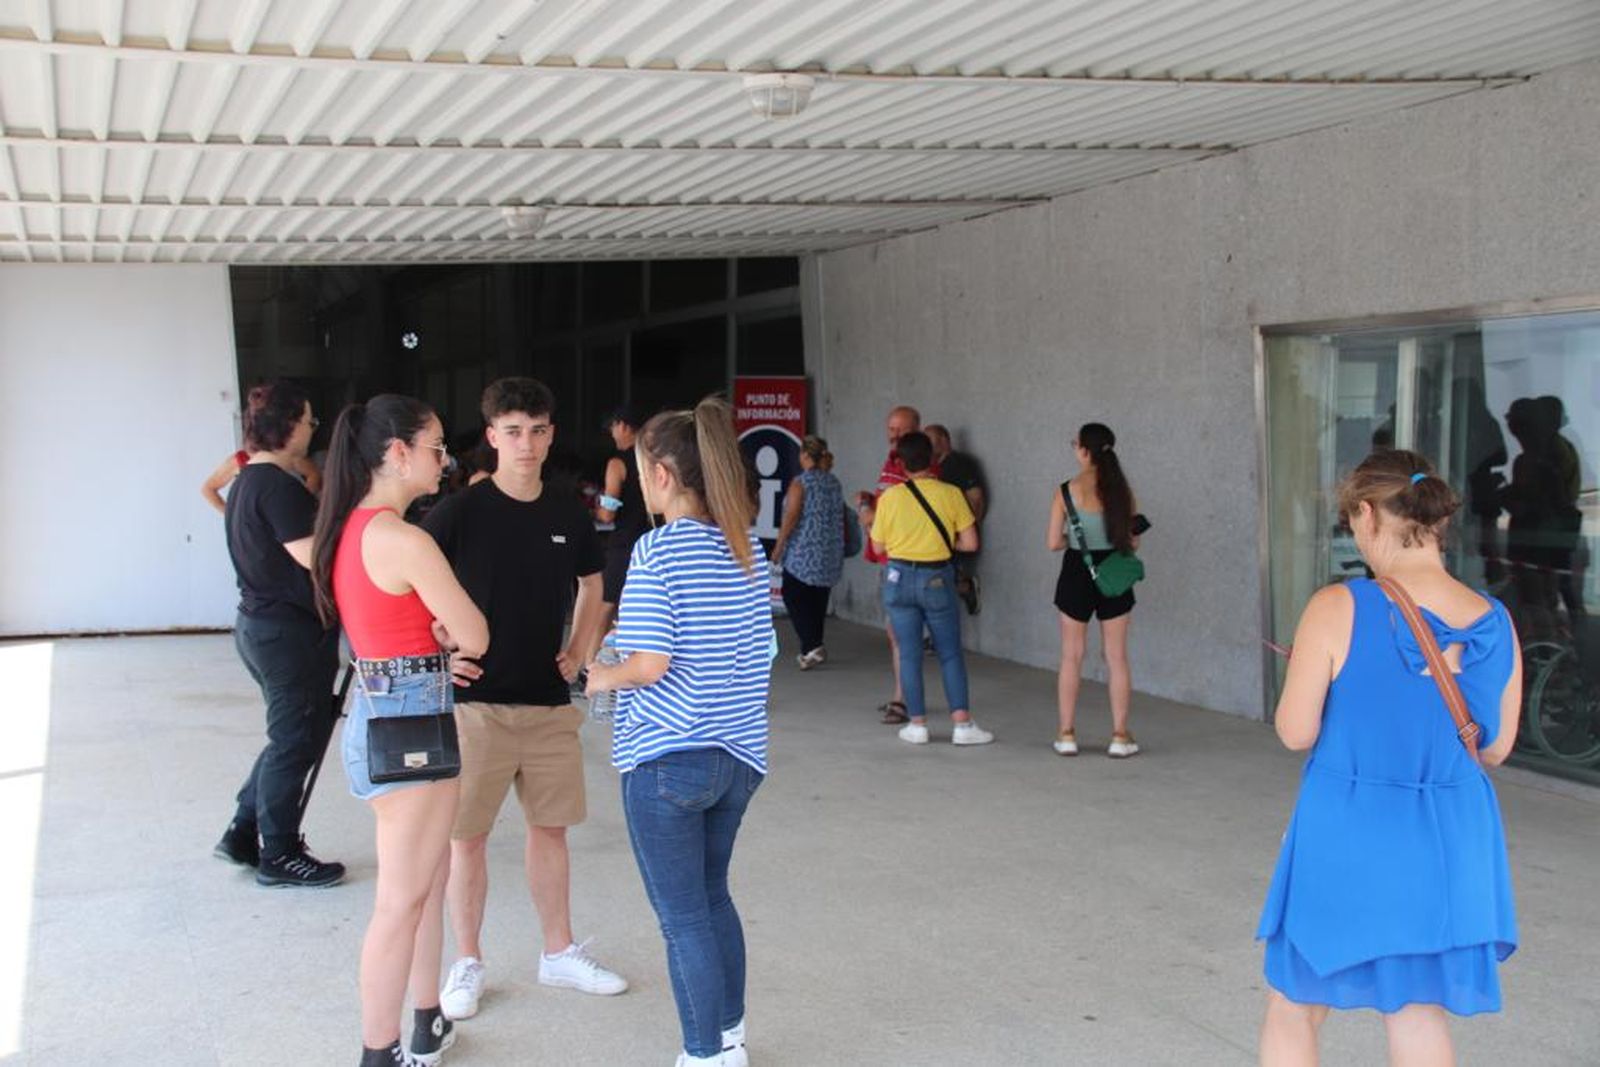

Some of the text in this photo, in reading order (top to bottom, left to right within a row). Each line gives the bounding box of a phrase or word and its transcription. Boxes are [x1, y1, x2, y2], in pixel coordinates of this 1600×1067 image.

[746, 393, 791, 406] PUNTO DE
[737, 406, 801, 420] INFORMACIÓN
